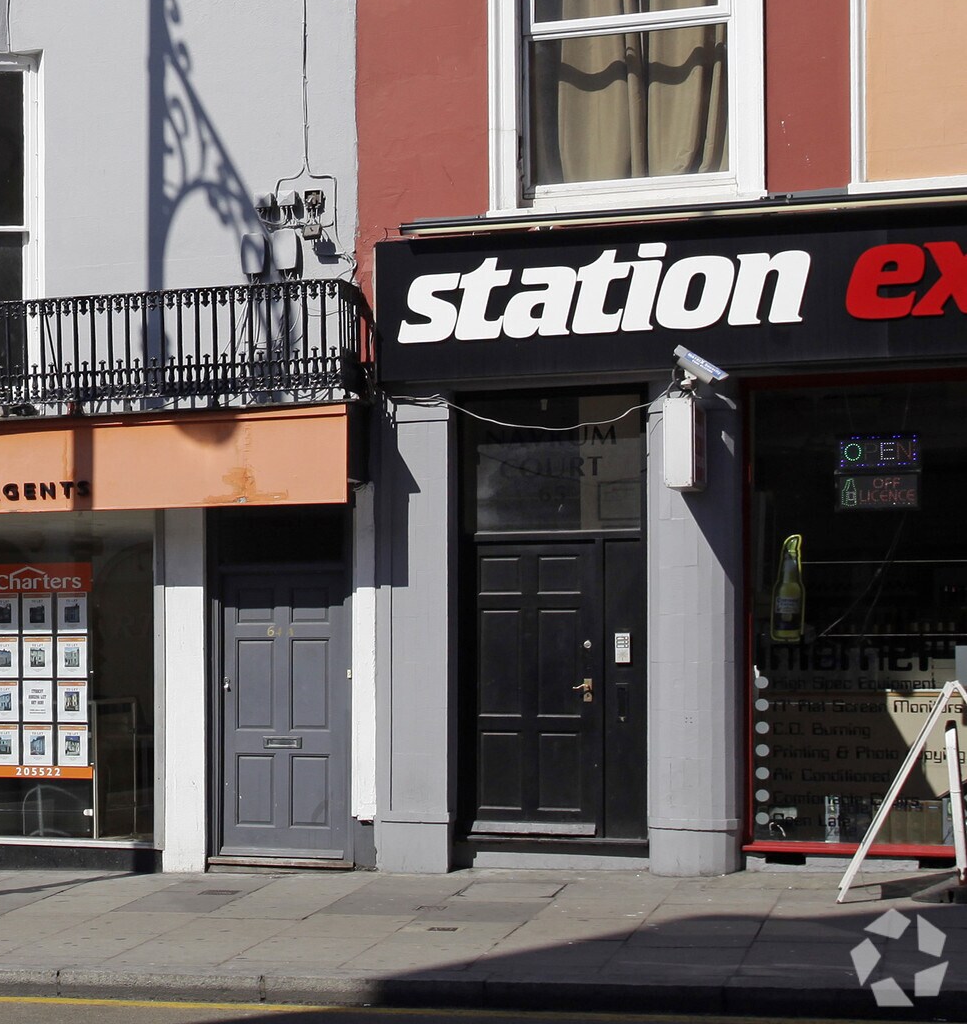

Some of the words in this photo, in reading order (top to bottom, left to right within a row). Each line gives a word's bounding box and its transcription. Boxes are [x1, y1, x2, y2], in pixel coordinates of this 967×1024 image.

[397, 242, 811, 344] station
[844, 442, 911, 461] OPEN
[858, 676, 936, 691] Equipment
[894, 700, 963, 713] Moniors
[813, 723, 870, 738] Burning
[773, 747, 830, 761] Printing
[856, 747, 899, 758] Photo
[16, 767, 60, 776] 205522
[802, 768, 890, 782] Conditioned
